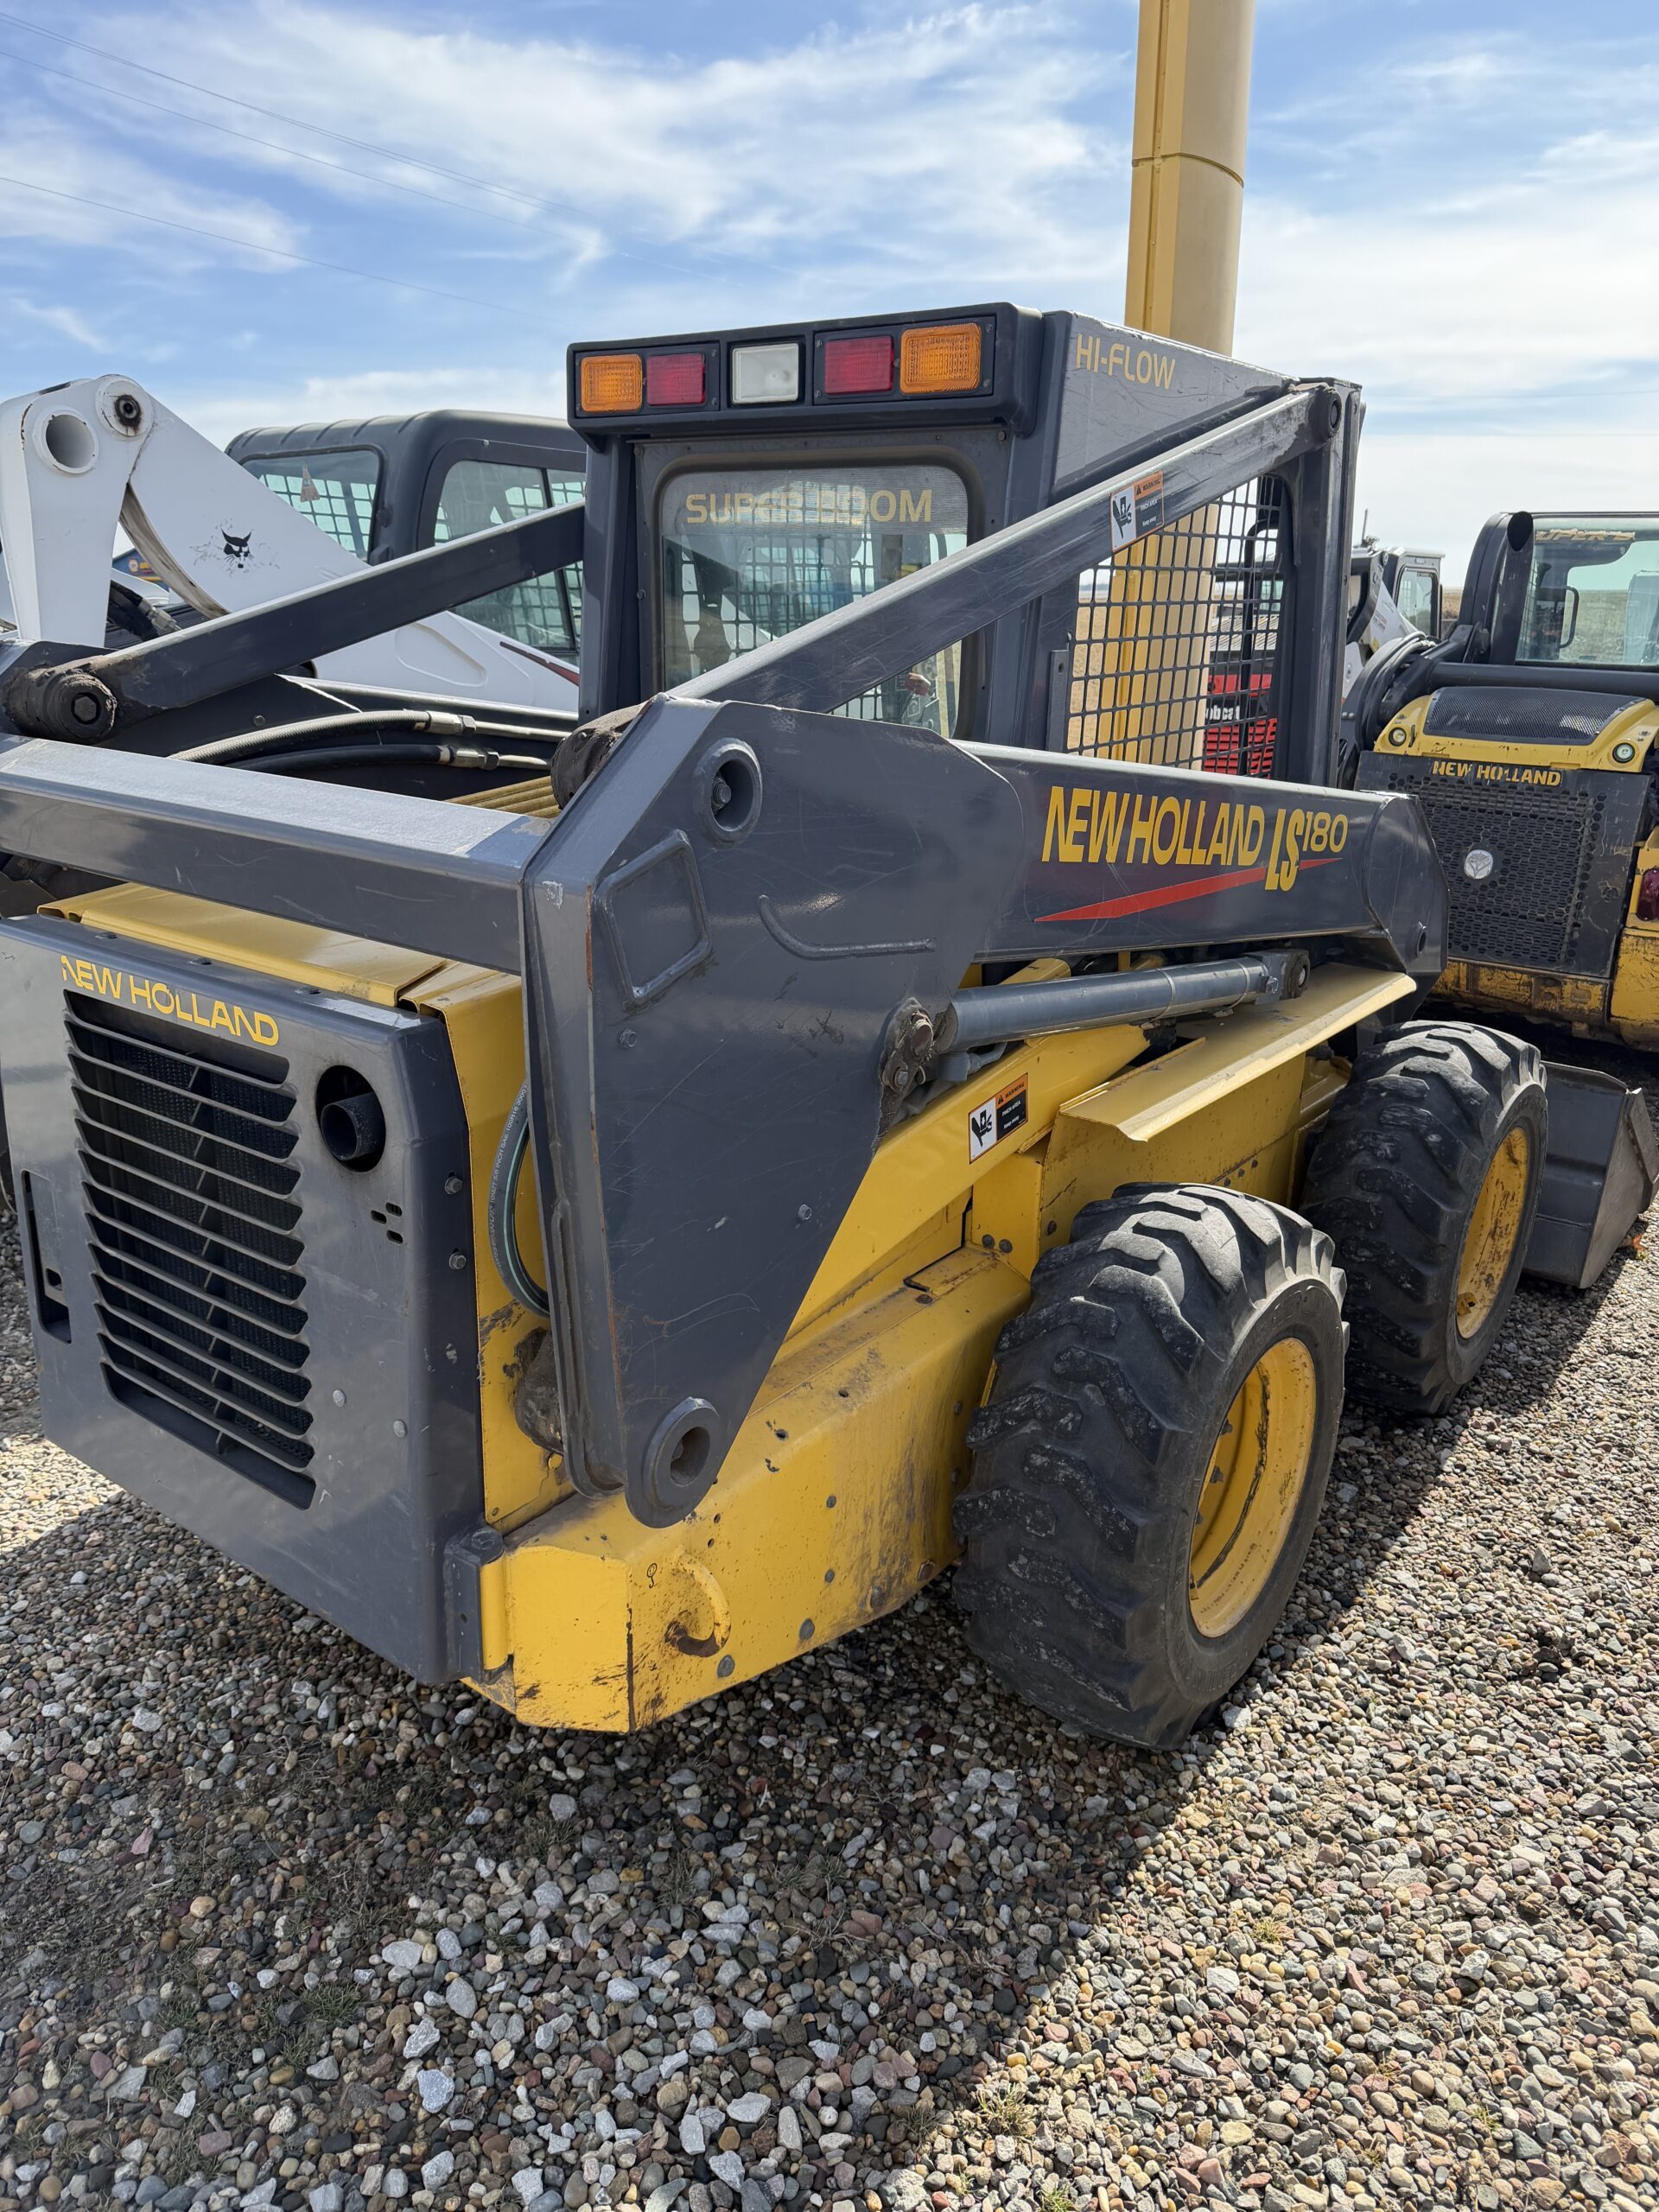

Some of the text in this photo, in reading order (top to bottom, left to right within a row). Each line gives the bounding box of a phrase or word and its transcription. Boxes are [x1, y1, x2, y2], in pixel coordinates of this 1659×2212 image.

[1076, 333, 1175, 390] HI-FLOW
[685, 489, 932, 524] SUPER BOOM
[1205, 704, 1241, 721] obcat
[1432, 760, 1561, 786] NEW HOLLAND
[1041, 785, 1131, 864] NEW
[1126, 794, 1266, 867] HOLLAND
[60, 955, 280, 1046] NEW HOLLAND
[496, 1149, 505, 1168] INCH
